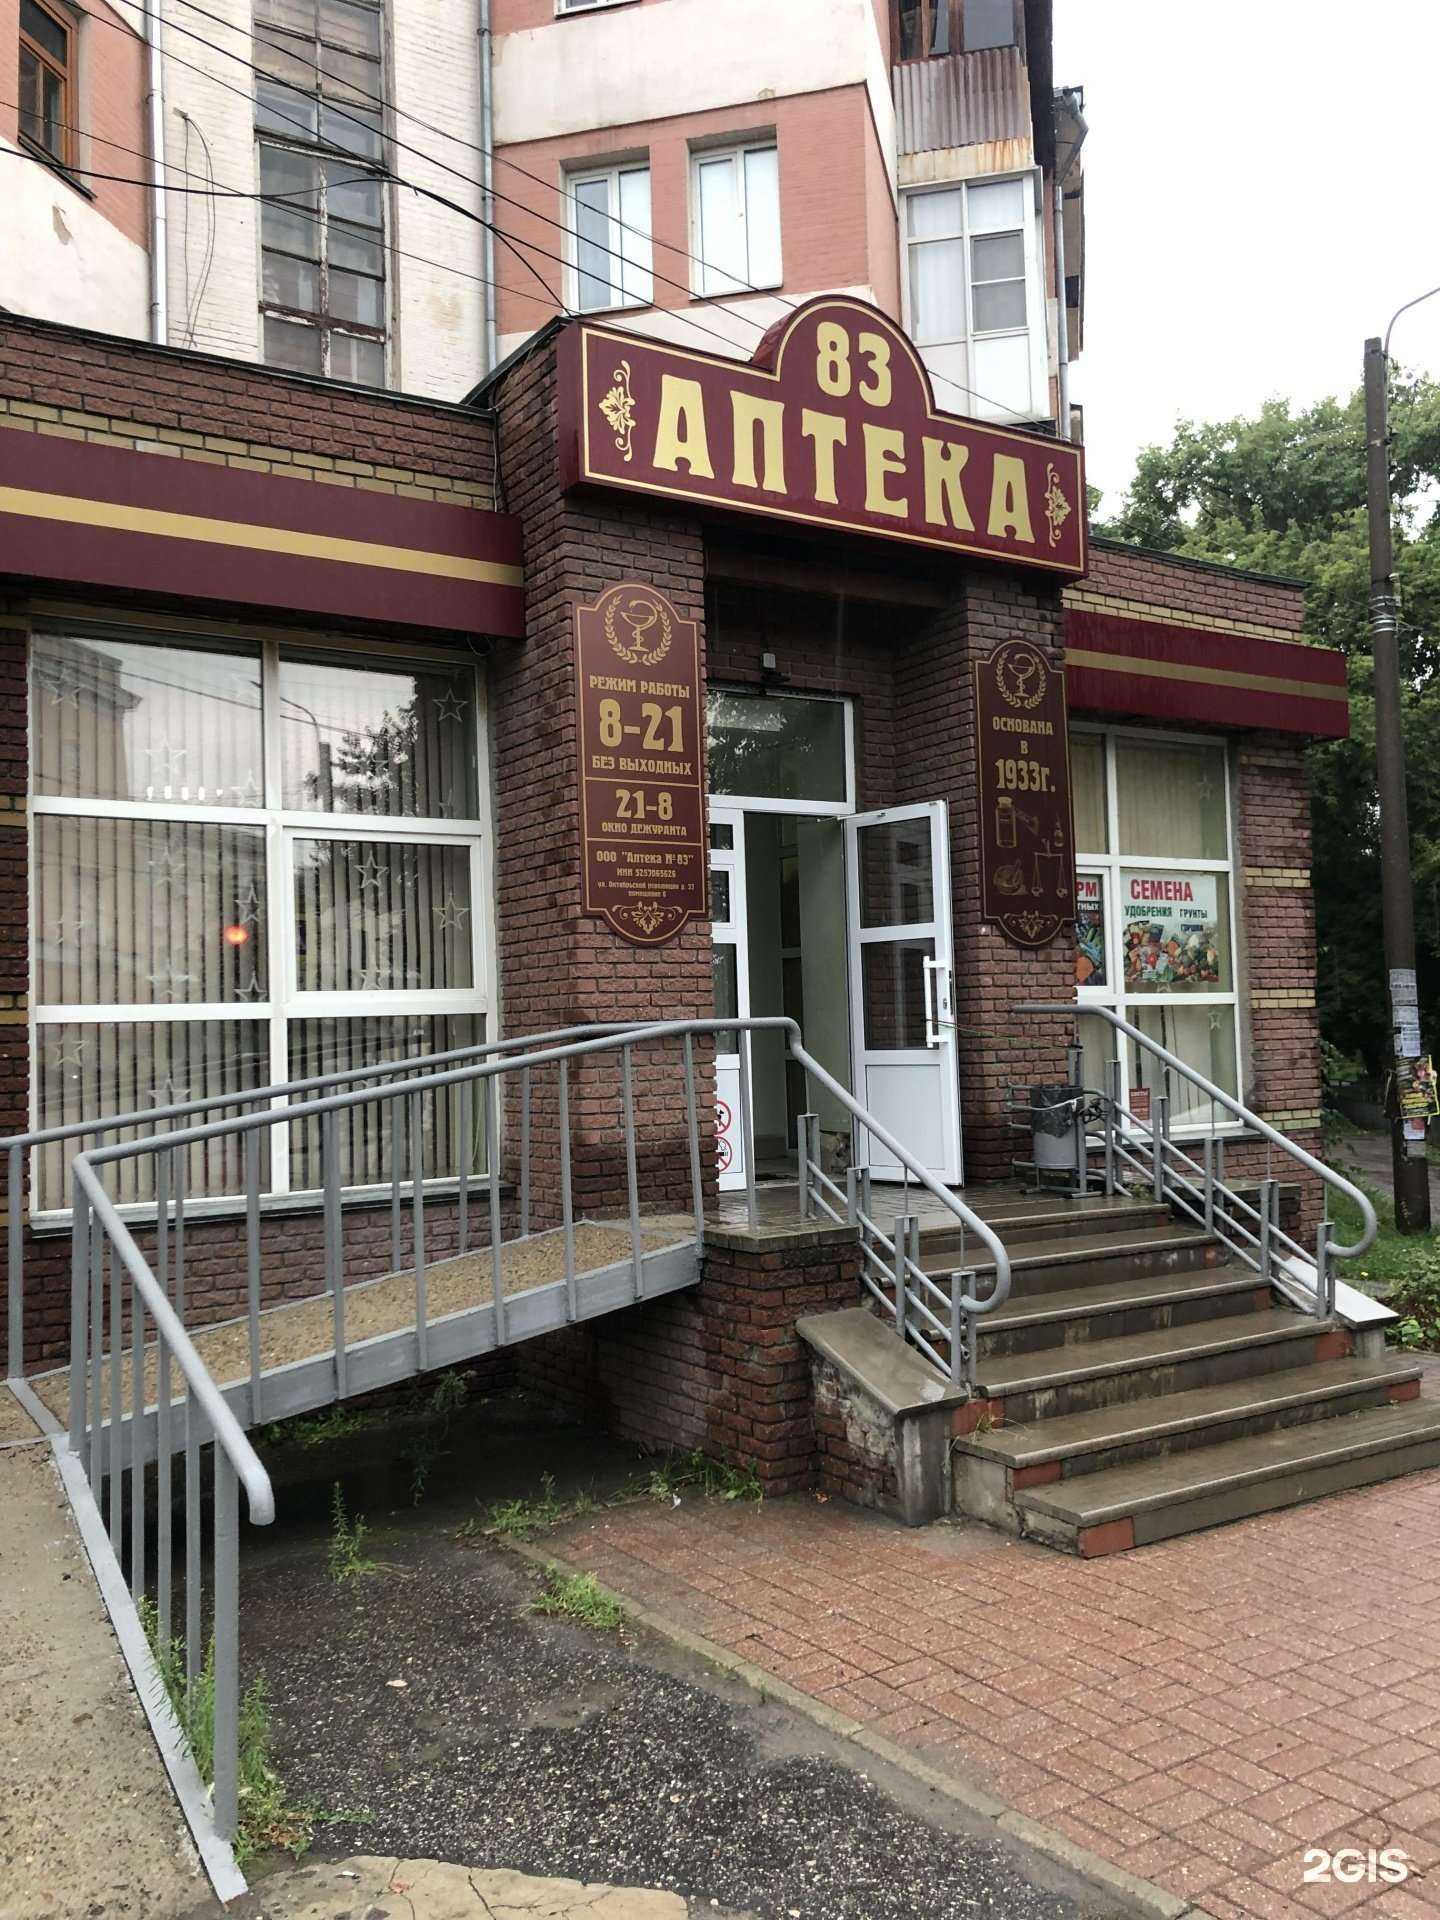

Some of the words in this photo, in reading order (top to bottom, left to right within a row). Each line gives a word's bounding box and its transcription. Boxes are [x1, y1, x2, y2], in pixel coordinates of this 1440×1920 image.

[816, 320, 892, 407] 83
[652, 373, 1036, 544] АПТЕКА
[589, 675, 636, 692] РЕЖИМ
[640, 680, 690, 698] РАБОТЫ
[599, 698, 684, 753] 8-21
[992, 715, 1053, 736] ОСНОВАНА
[592, 755, 615, 769] БЕЗ
[619, 757, 692, 775] ВЫХОДНЫХ
[615, 788, 673, 821] 21-8
[601, 821, 627, 833] ОКНО
[630, 823, 687, 836] ДЕЖУРАНТА
[596, 850, 617, 862] ООО
[1130, 879, 1194, 901] СЕМЕНА
[1124, 905, 1172, 918] УДОБРЕНИЯ
[1179, 908, 1208, 919] ГРУНТЫ
